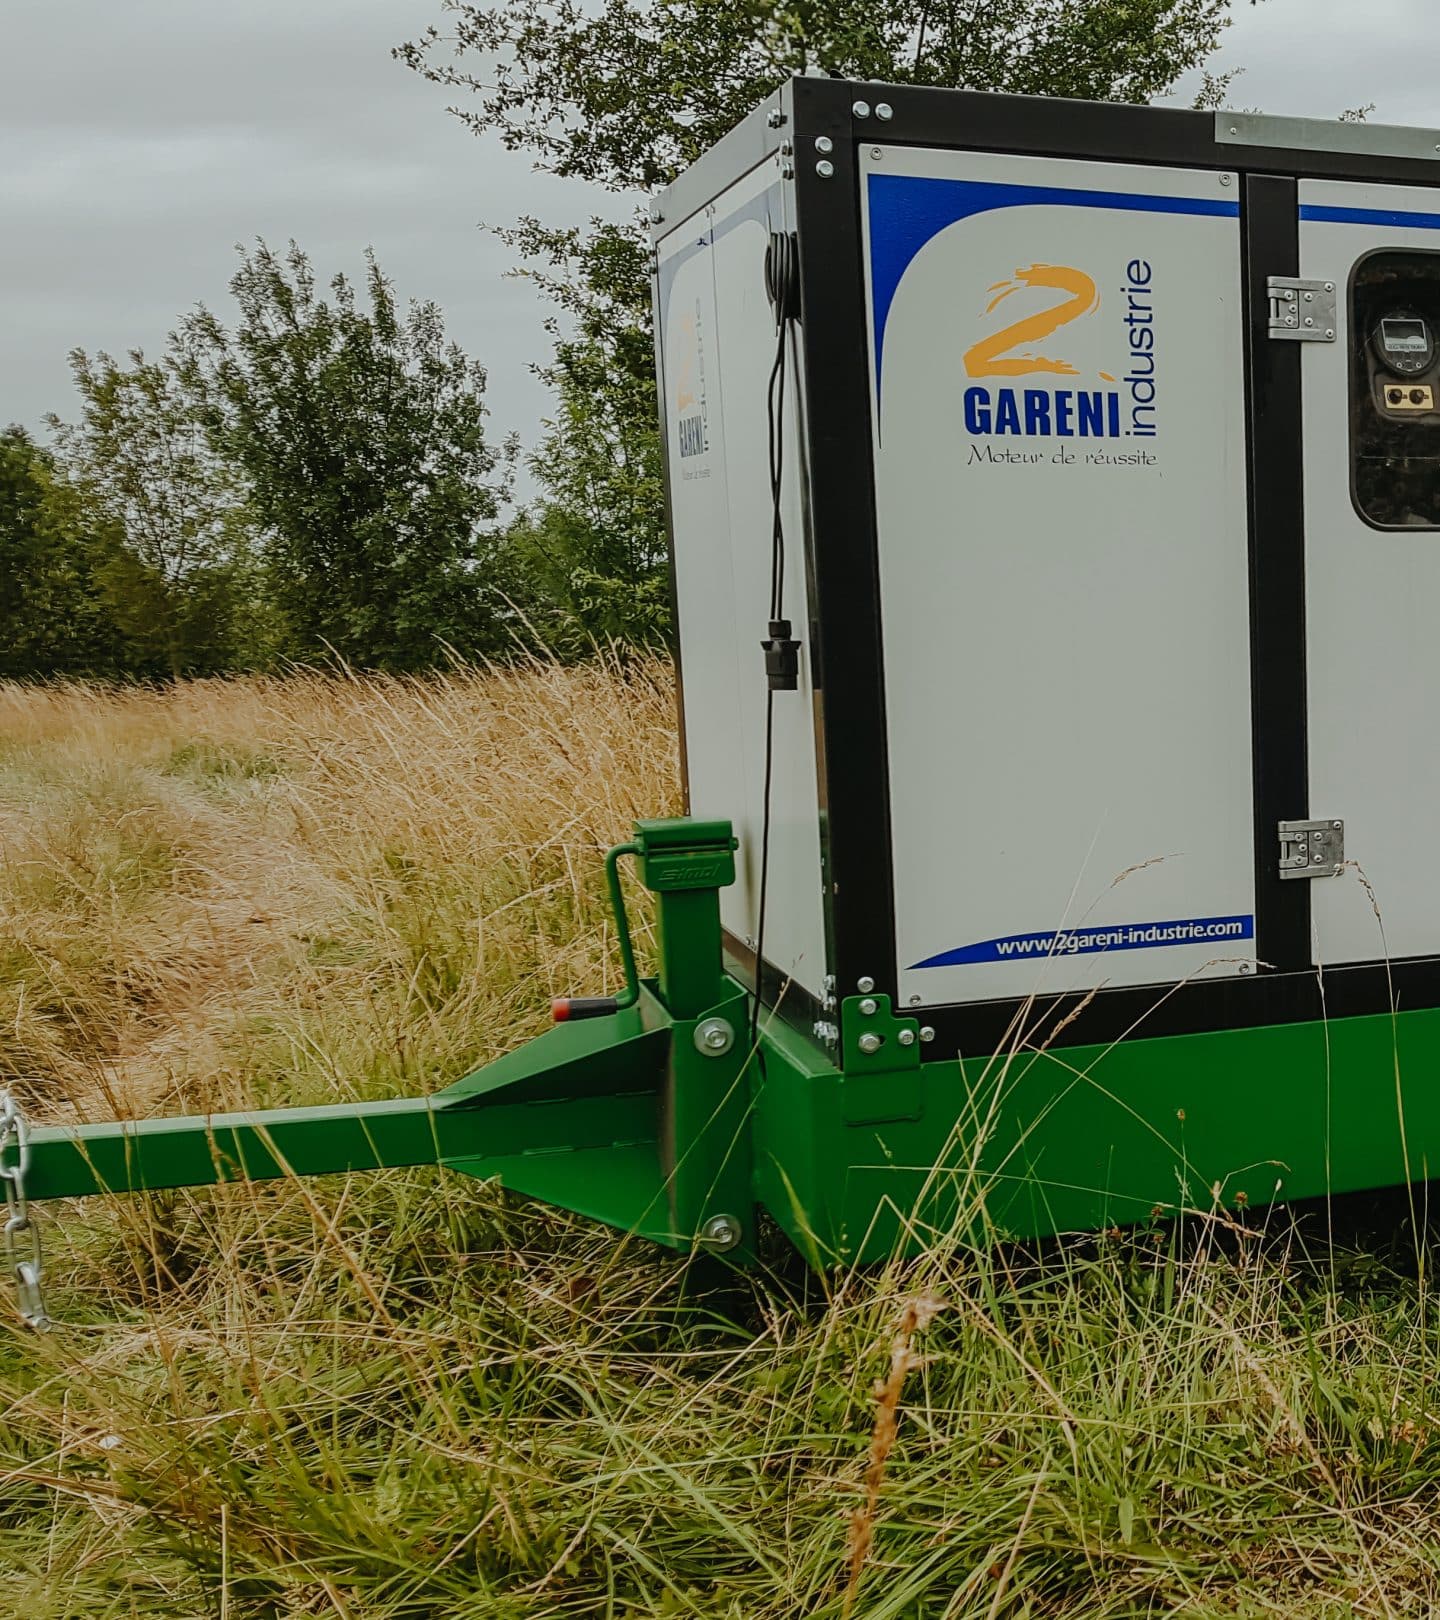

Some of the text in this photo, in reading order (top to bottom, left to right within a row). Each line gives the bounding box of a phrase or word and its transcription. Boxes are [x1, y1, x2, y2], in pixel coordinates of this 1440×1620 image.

[963, 263, 1101, 378] 2
[1120, 259, 1157, 436] industrie
[963, 386, 1120, 438] GARENI
[967, 444, 1158, 466] Moteur de réussite
[996, 919, 1243, 955] www2gareni-industrie.com
